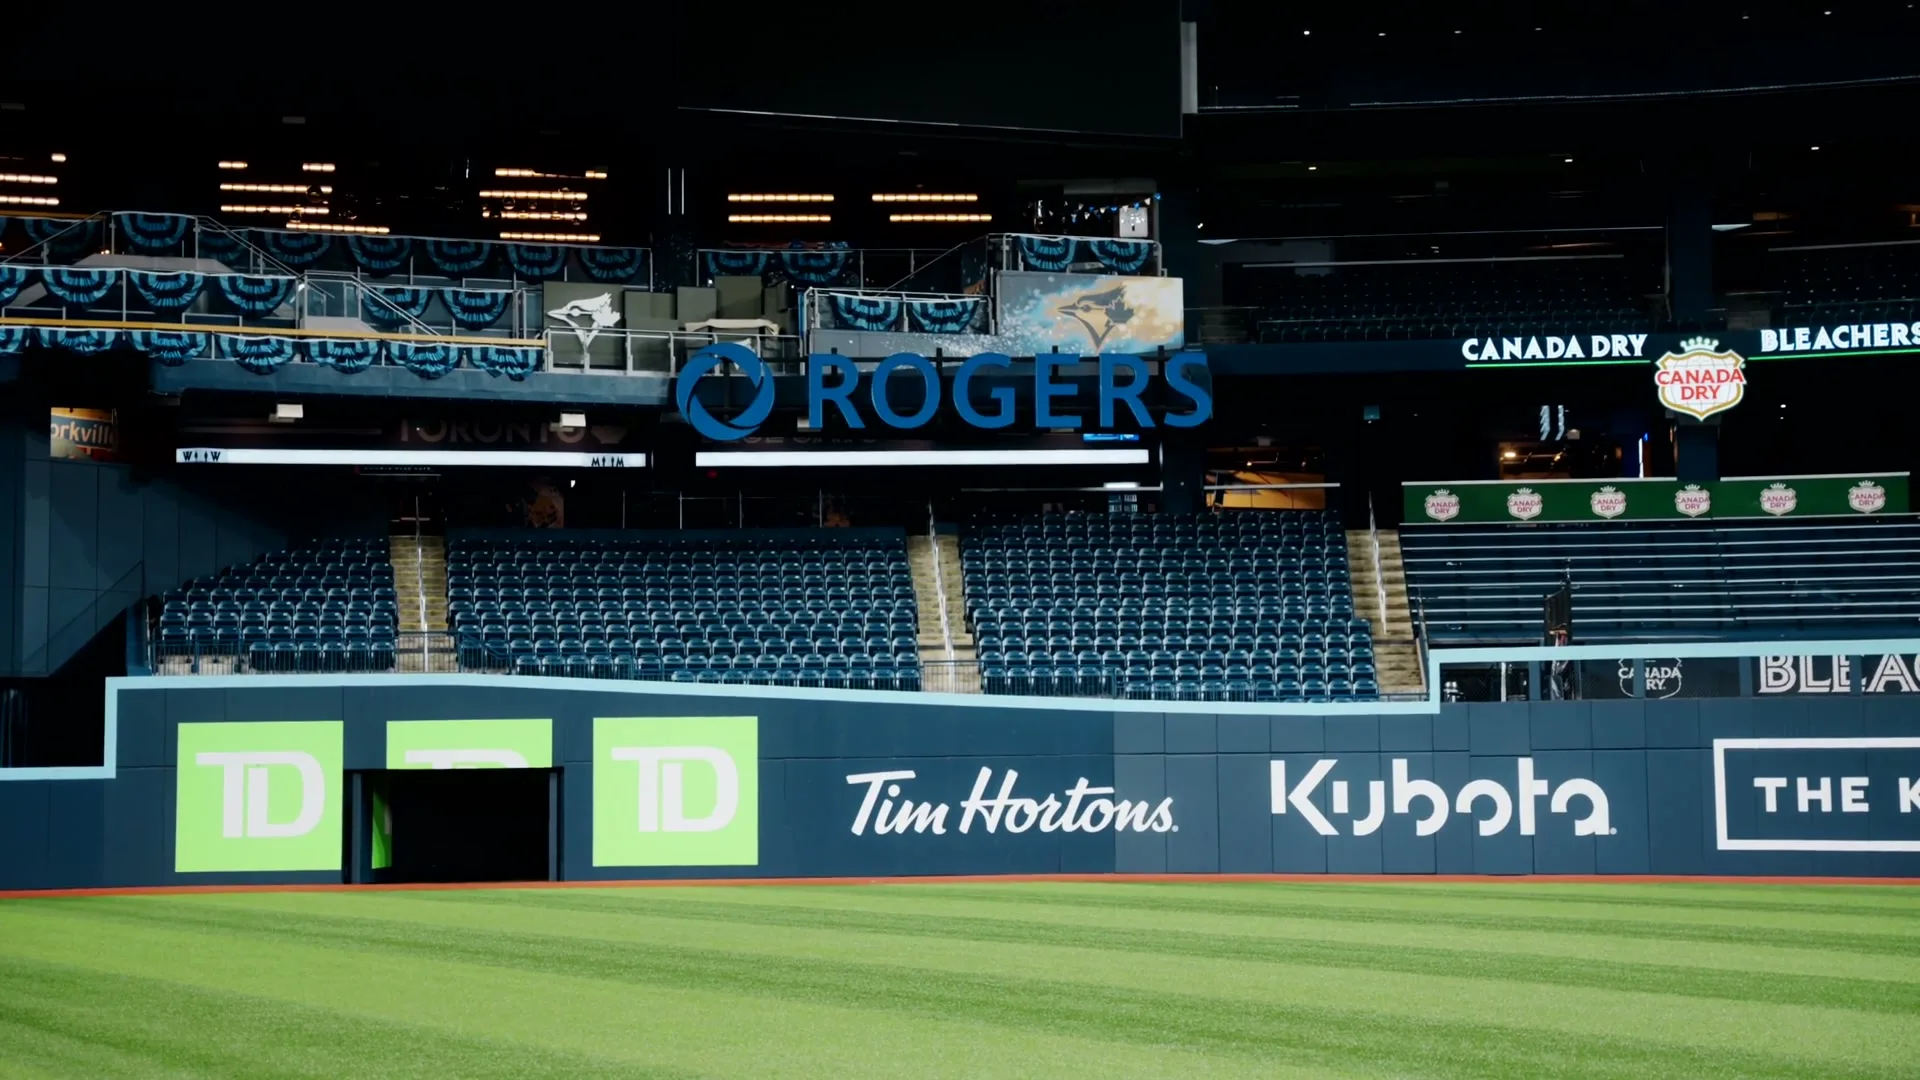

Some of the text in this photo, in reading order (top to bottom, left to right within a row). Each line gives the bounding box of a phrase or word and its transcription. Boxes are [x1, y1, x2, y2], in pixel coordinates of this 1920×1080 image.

[1461, 334, 1649, 361] CANADA DRY
[1760, 321, 1920, 352] BLEACHERS
[808, 351, 1213, 429] ROGERS
[1658, 368, 1744, 385] CANADA
[1681, 385, 1721, 400] DRY
[1761, 495, 1796, 503] CANADA
[1850, 493, 1885, 501] CANADA
[1858, 499, 1875, 507] DRY
[195, 751, 326, 838] TD
[611, 746, 739, 833] TD
[846, 769, 950, 836] Tim
[1753, 777, 1870, 813] THE
